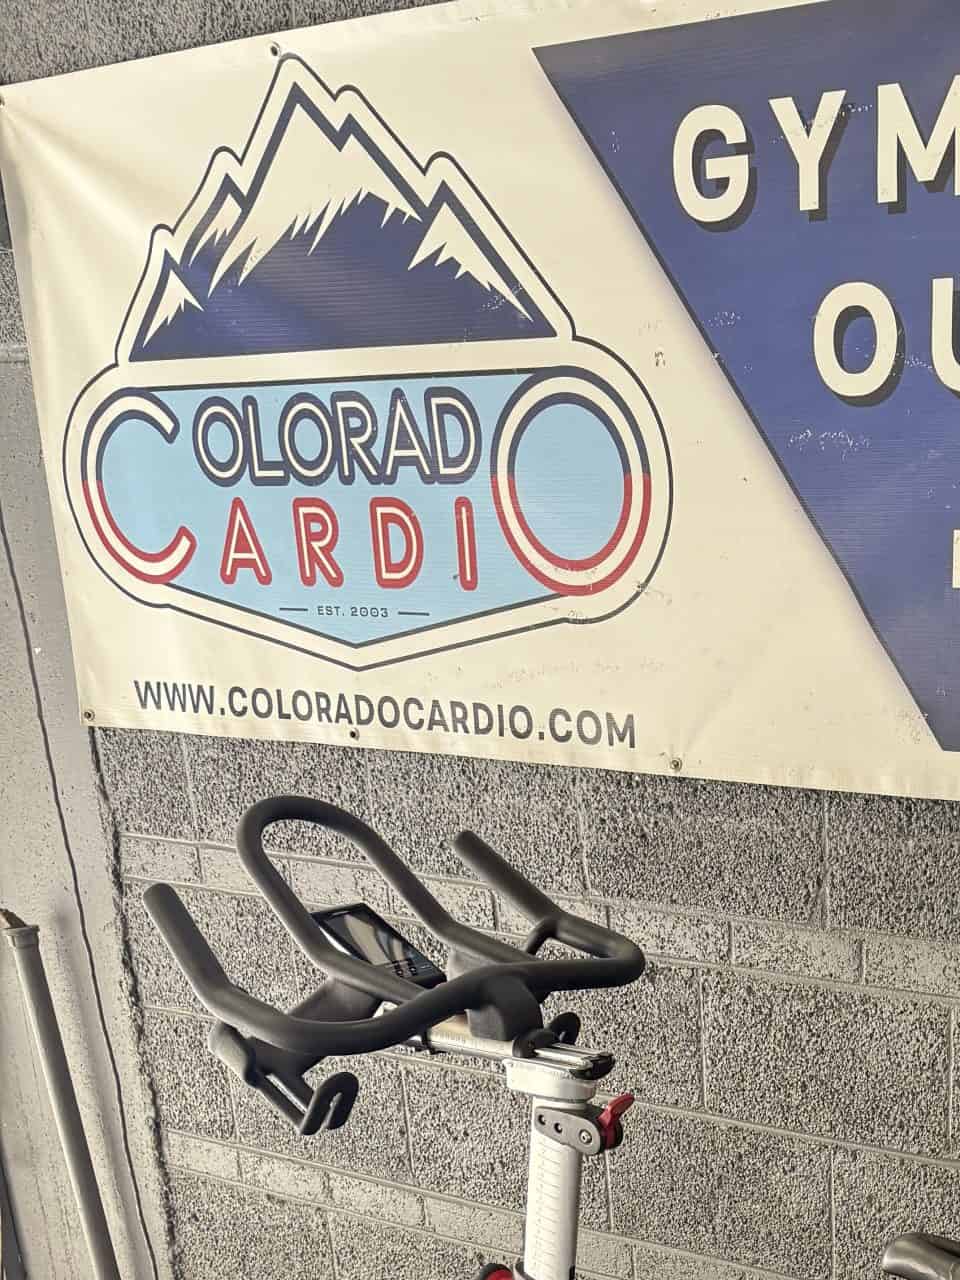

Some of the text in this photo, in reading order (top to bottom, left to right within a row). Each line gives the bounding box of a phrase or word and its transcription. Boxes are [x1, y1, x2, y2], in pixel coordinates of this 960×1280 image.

[317, 605, 389, 618] EST. 2003
[134, 680, 637, 748] WWW.COLORADOCARDIO.COM
